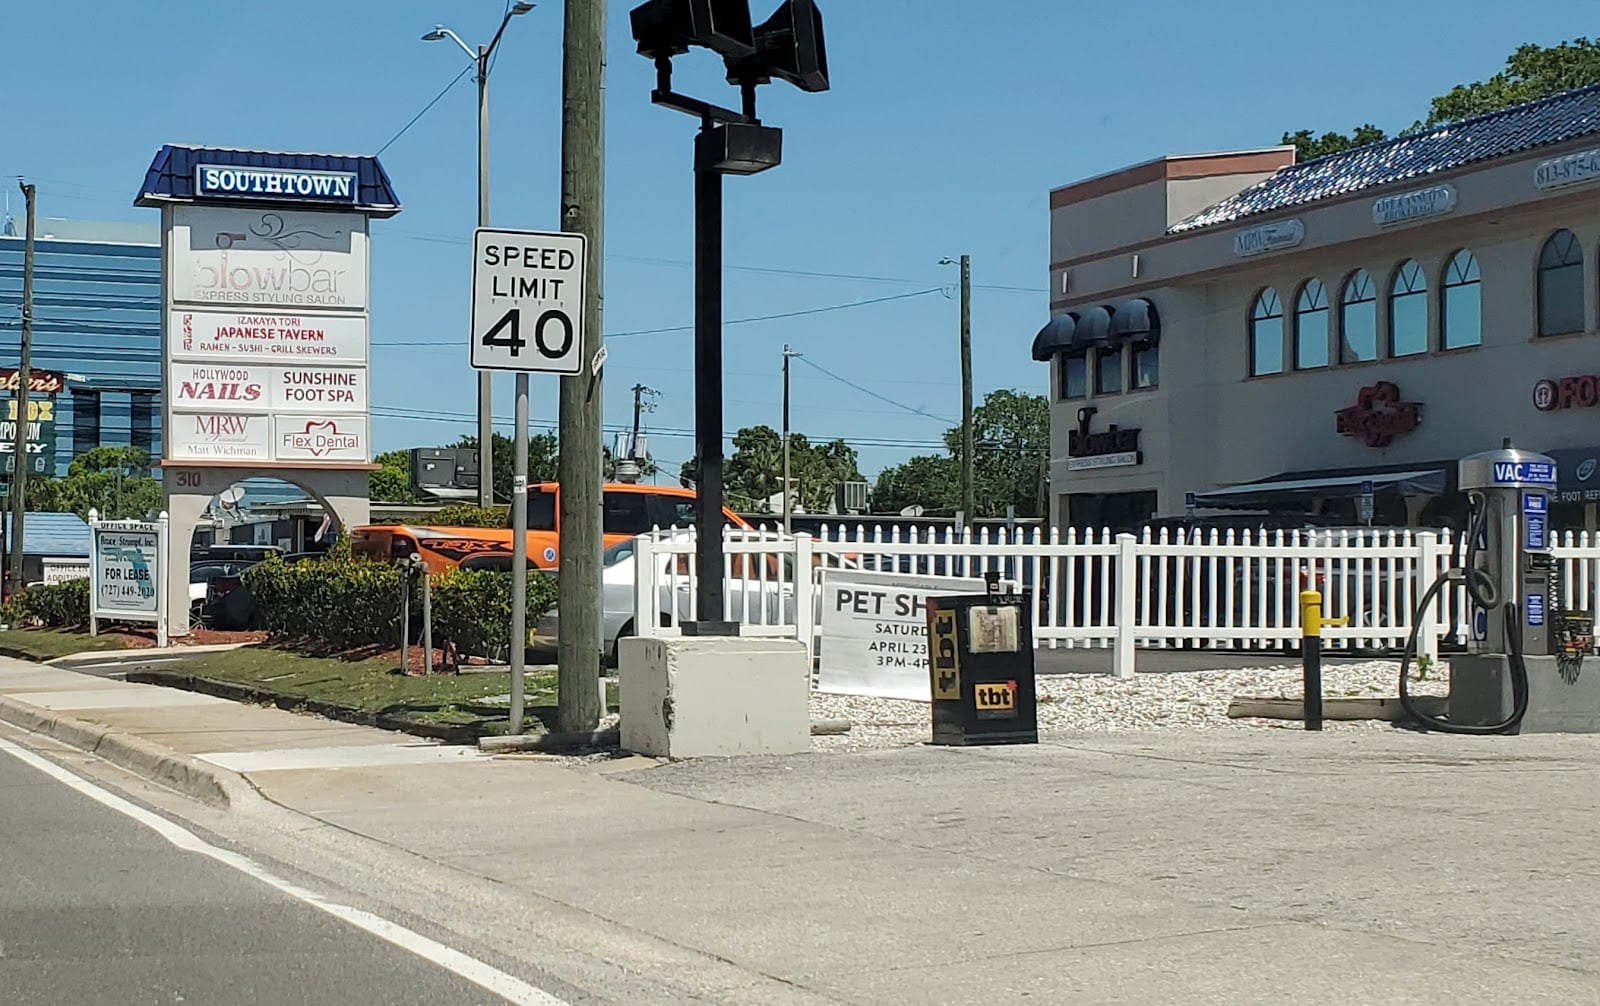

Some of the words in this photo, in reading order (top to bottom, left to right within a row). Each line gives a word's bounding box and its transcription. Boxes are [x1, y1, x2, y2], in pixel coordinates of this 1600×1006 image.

[1536, 157, 1600, 184] 813-875-6
[206, 169, 351, 196] SOUTHTOWN
[485, 245, 574, 270] SPEED
[493, 276, 564, 299] LIMIT
[252, 292, 303, 304] STYLING
[306, 294, 346, 305] SALON
[237, 316, 277, 326] IZAKAYA
[279, 317, 301, 327] TORI
[214, 327, 275, 341] JAPANESE
[279, 328, 324, 341] TAVERN
[482, 309, 573, 359] 40
[238, 344, 263, 353] SUSHI
[271, 344, 294, 354] GRILL
[296, 345, 337, 355] SKEWERS
[192, 368, 249, 380] HOLLYWOOD
[283, 371, 357, 386] SUNSHINE
[178, 382, 261, 401] NAILS
[285, 388, 325, 402] FOOT
[327, 389, 354, 402] SPA
[195, 415, 250, 435] MRW
[283, 434, 312, 447] Flex
[316, 434, 359, 449] Dental
[176, 472, 201, 487] 310
[1495, 464, 1523, 481] VAC
[1561, 490, 1581, 502] FOOT
[105, 567, 122, 580] FOR
[123, 568, 150, 581] LEASE
[101, 584, 120, 598] (727)
[836, 588, 886, 614] PET
[894, 593, 927, 618] SH
[875, 623, 928, 637] SATURD
[868, 641, 909, 654] APRIL
[936, 615, 956, 692] tbt
[876, 656, 929, 669] 3PM-4P
[978, 687, 1011, 706] tbt
